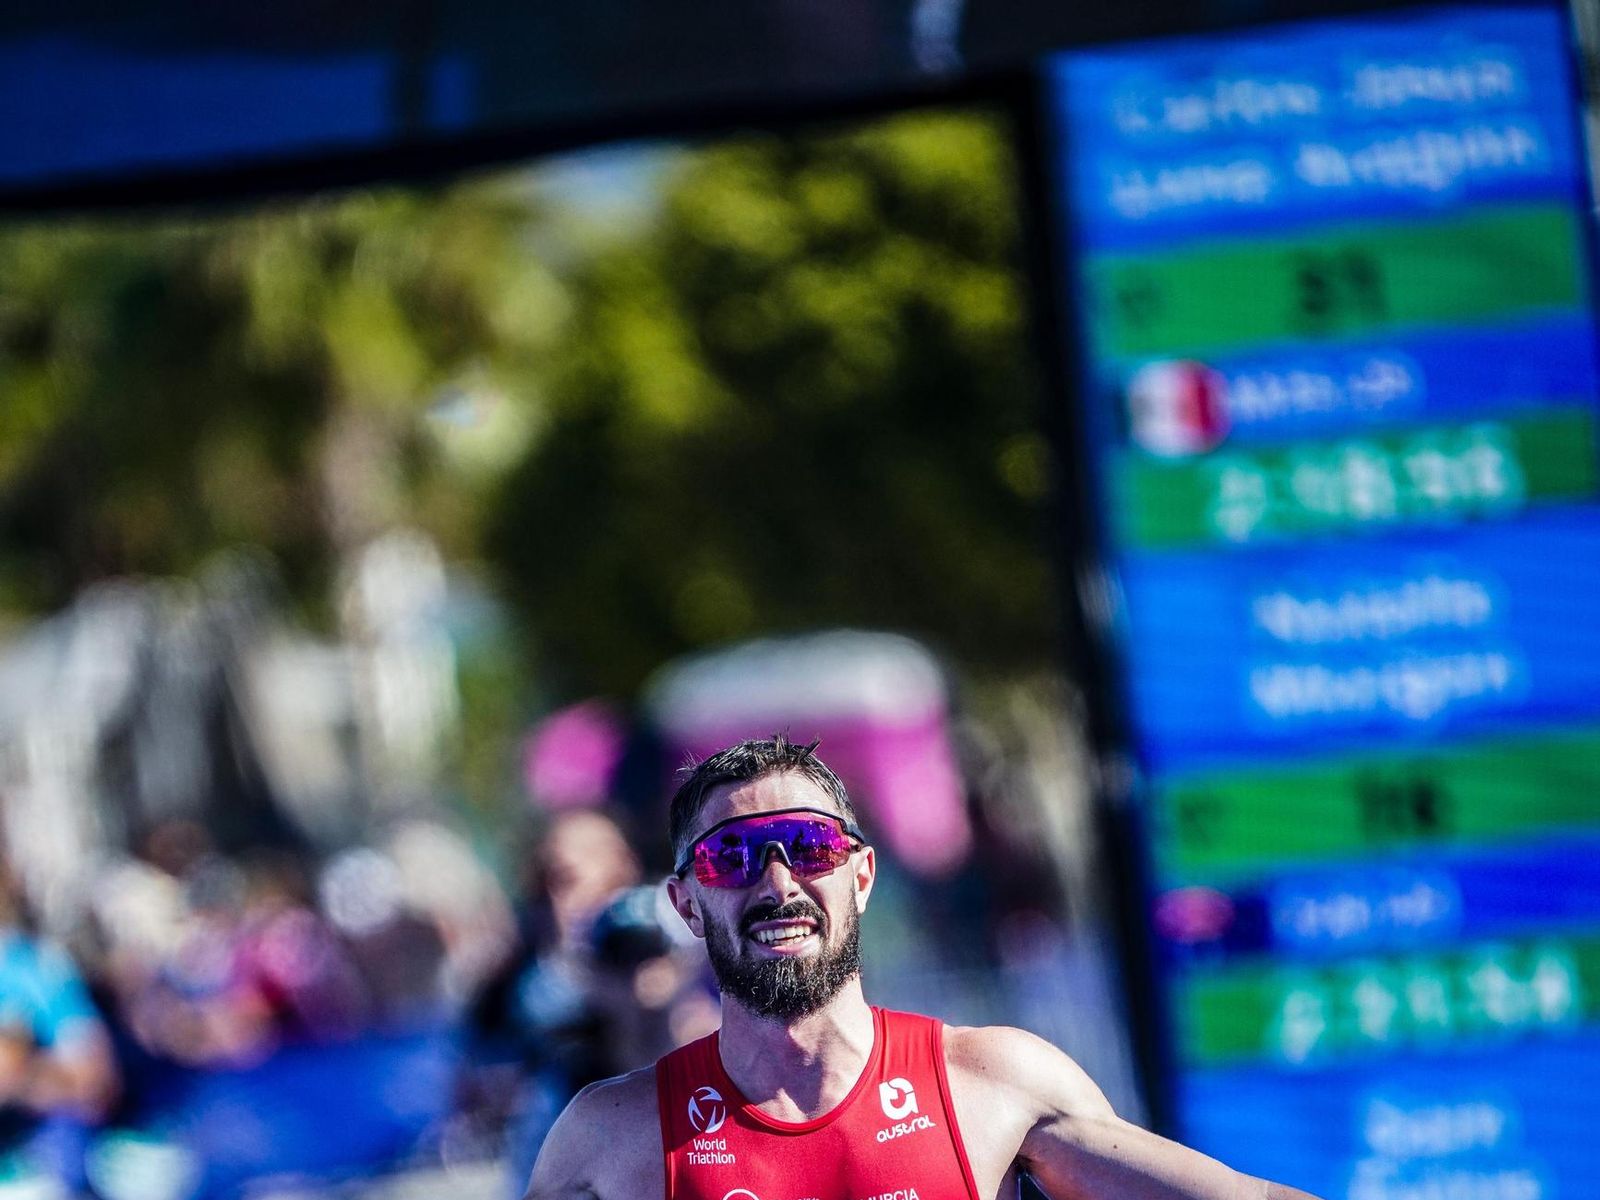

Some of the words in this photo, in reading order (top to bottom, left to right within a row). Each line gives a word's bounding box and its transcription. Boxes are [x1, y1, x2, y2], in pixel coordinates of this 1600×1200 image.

[876, 1114, 936, 1143] austral
[693, 1138, 727, 1151] World
[687, 1152, 736, 1165] Triathlon
